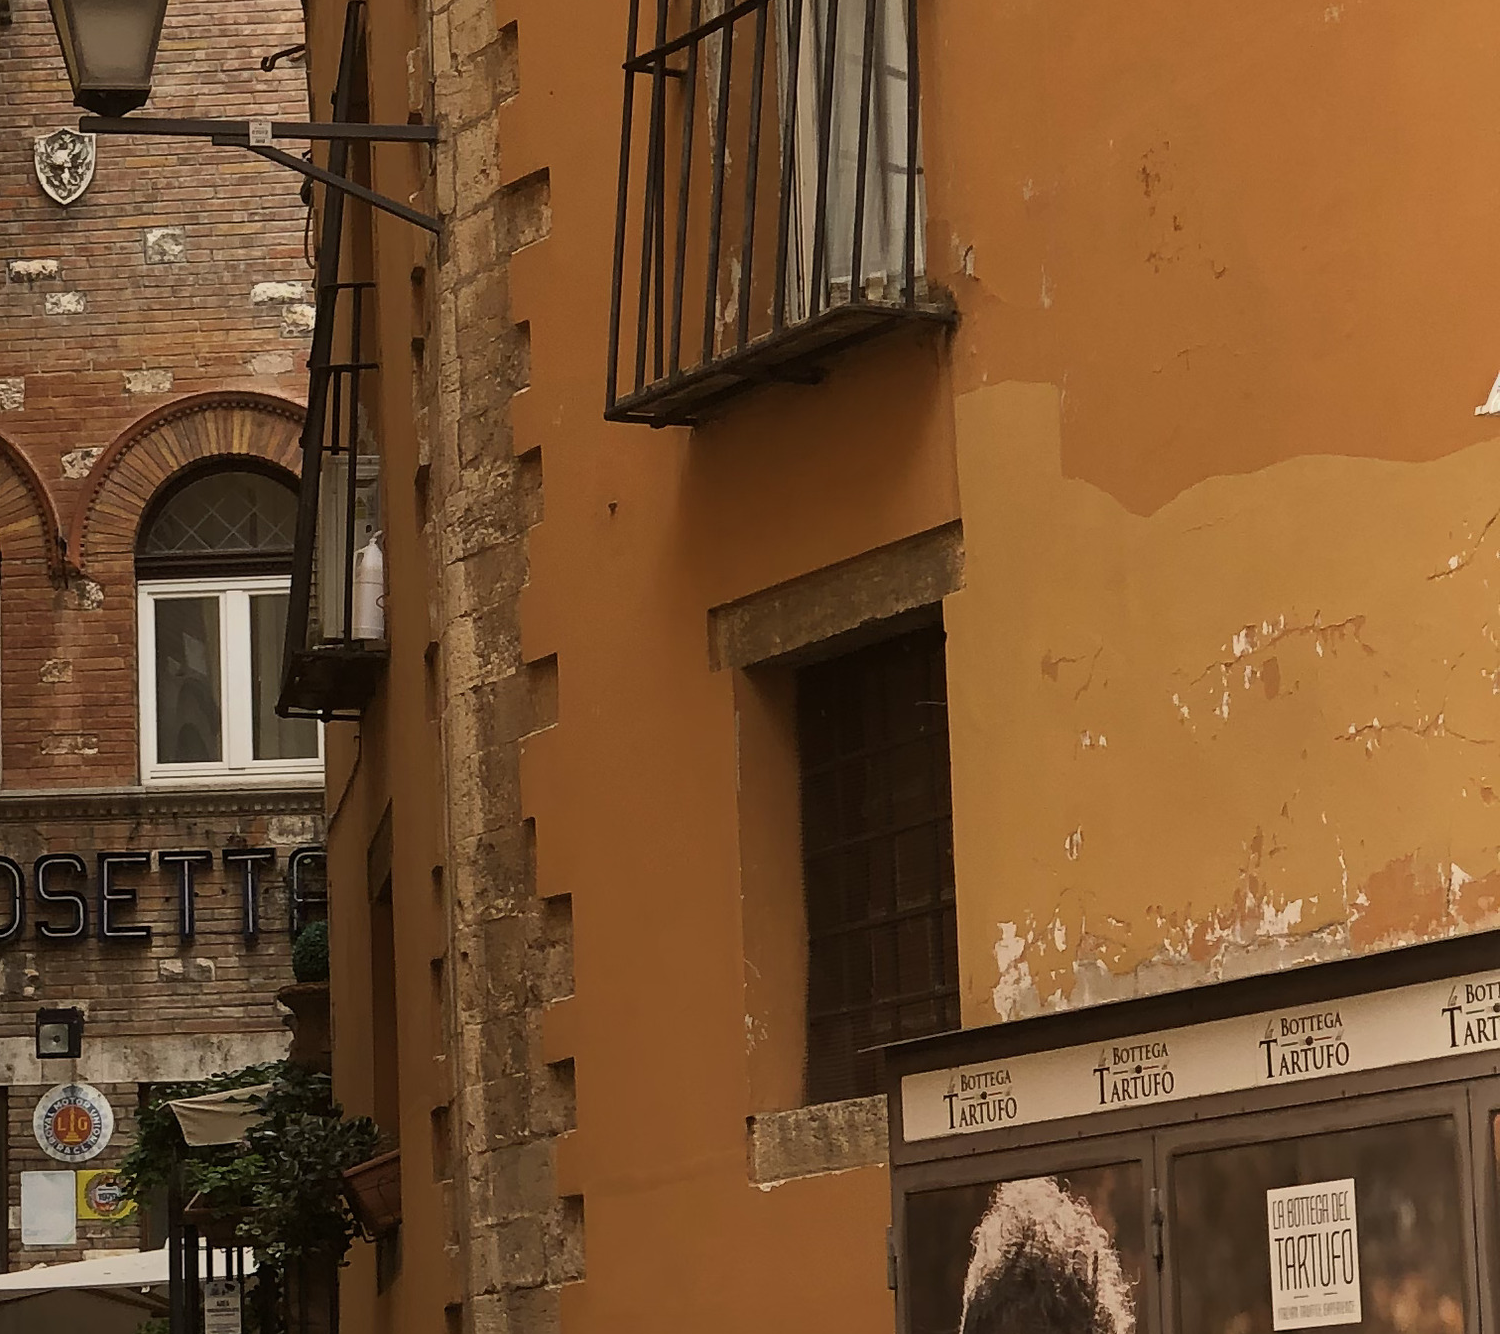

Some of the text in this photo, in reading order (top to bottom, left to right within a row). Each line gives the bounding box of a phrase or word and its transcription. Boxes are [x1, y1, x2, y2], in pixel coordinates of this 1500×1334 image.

[1281, 1011, 1343, 1036] BOTTEGA
[1113, 1043, 1168, 1065] BOTTEGA
[1259, 1038, 1349, 1078] TARTUFO
[961, 1070, 1011, 1092] BOTTEGA
[1093, 1067, 1174, 1104] TARTUFO
[44, 1097, 102, 1146] ROYAL MOTOR UNION
[943, 1093, 1017, 1129] TARTUFO
[1272, 1191, 1350, 1229] LA BOTTEGA DEL
[1275, 1229, 1354, 1291] TARTUFO
